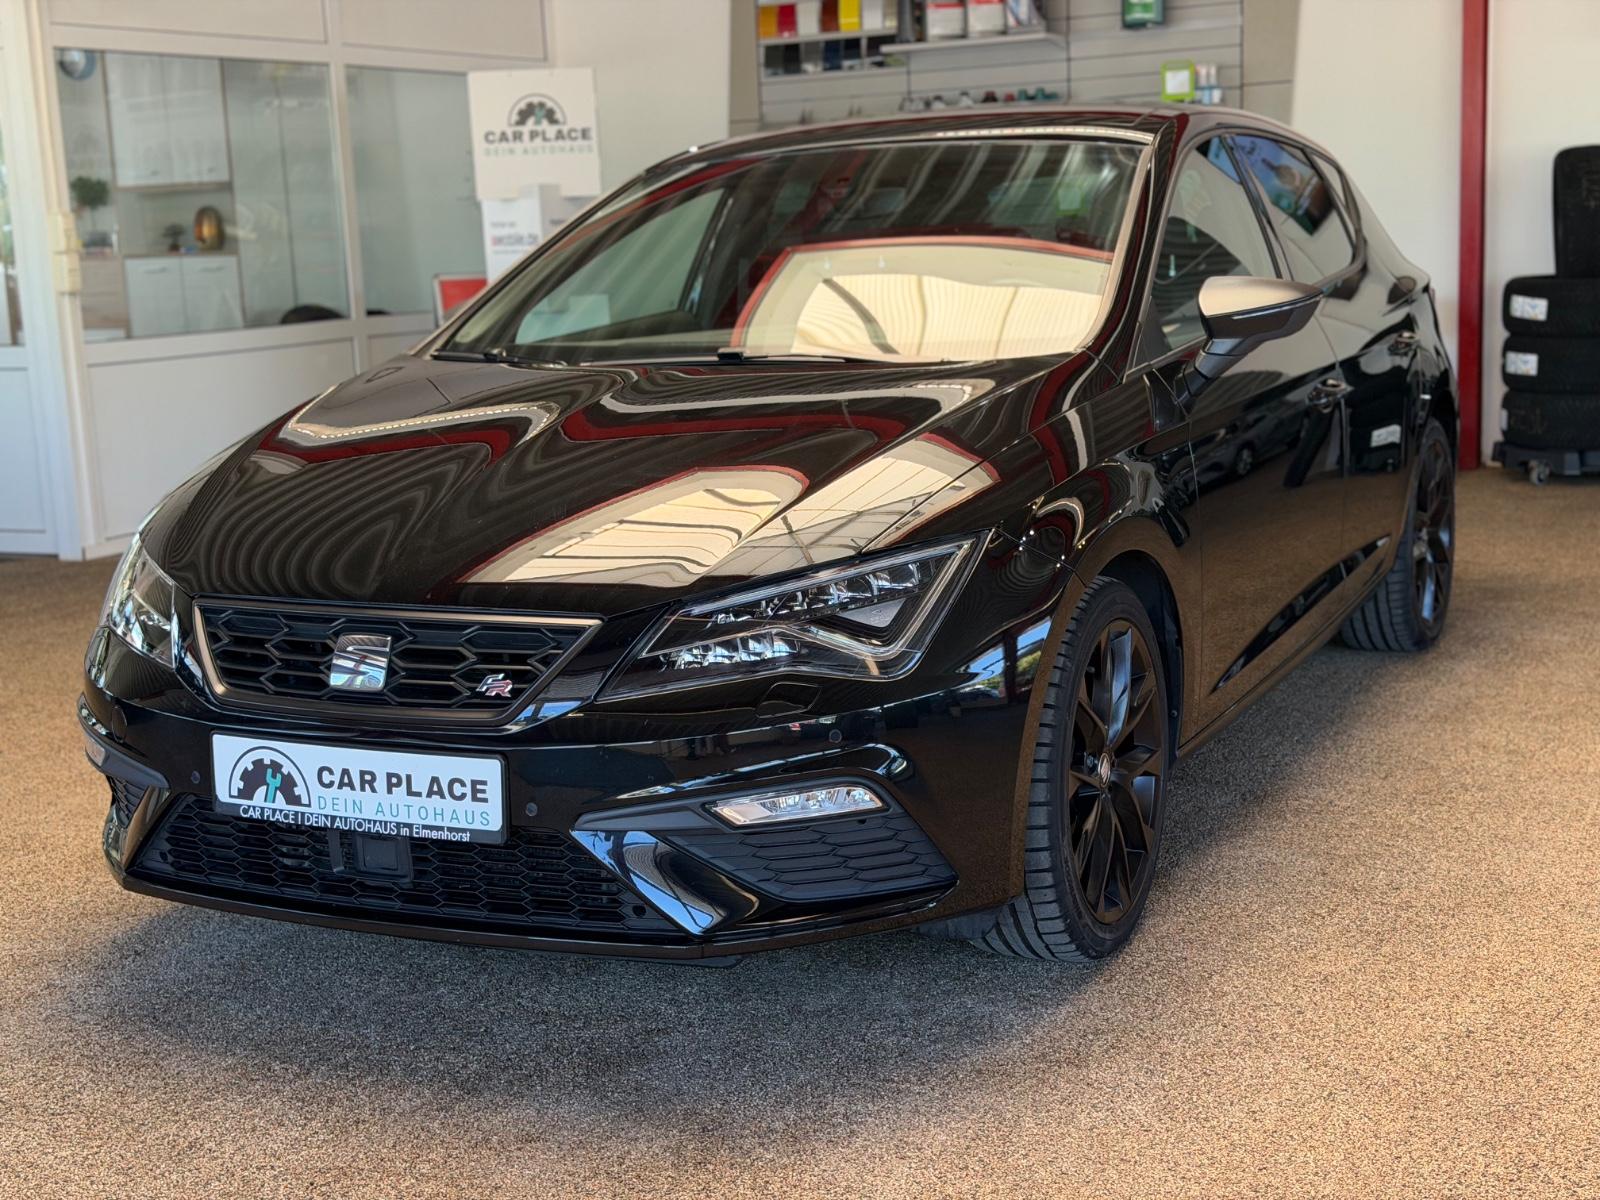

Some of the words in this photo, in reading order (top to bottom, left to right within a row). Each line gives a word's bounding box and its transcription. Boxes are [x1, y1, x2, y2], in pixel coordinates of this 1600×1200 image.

[484, 130, 523, 144] CAR
[529, 127, 592, 143] PLACE
[484, 146, 516, 156] DEIN
[522, 143, 593, 155] AUTOHAUS
[316, 765, 378, 794] CAR
[385, 771, 489, 804] PLACE
[240, 805, 262, 820] CAR
[264, 808, 295, 824] PLACE
[304, 814, 331, 829] DEIN
[333, 817, 397, 835] AUTOHAUS
[400, 824, 410, 837] in
[412, 824, 471, 842] Elmenhorst
[317, 795, 363, 815] DEIN
[375, 801, 490, 827] AUTOHAUS
